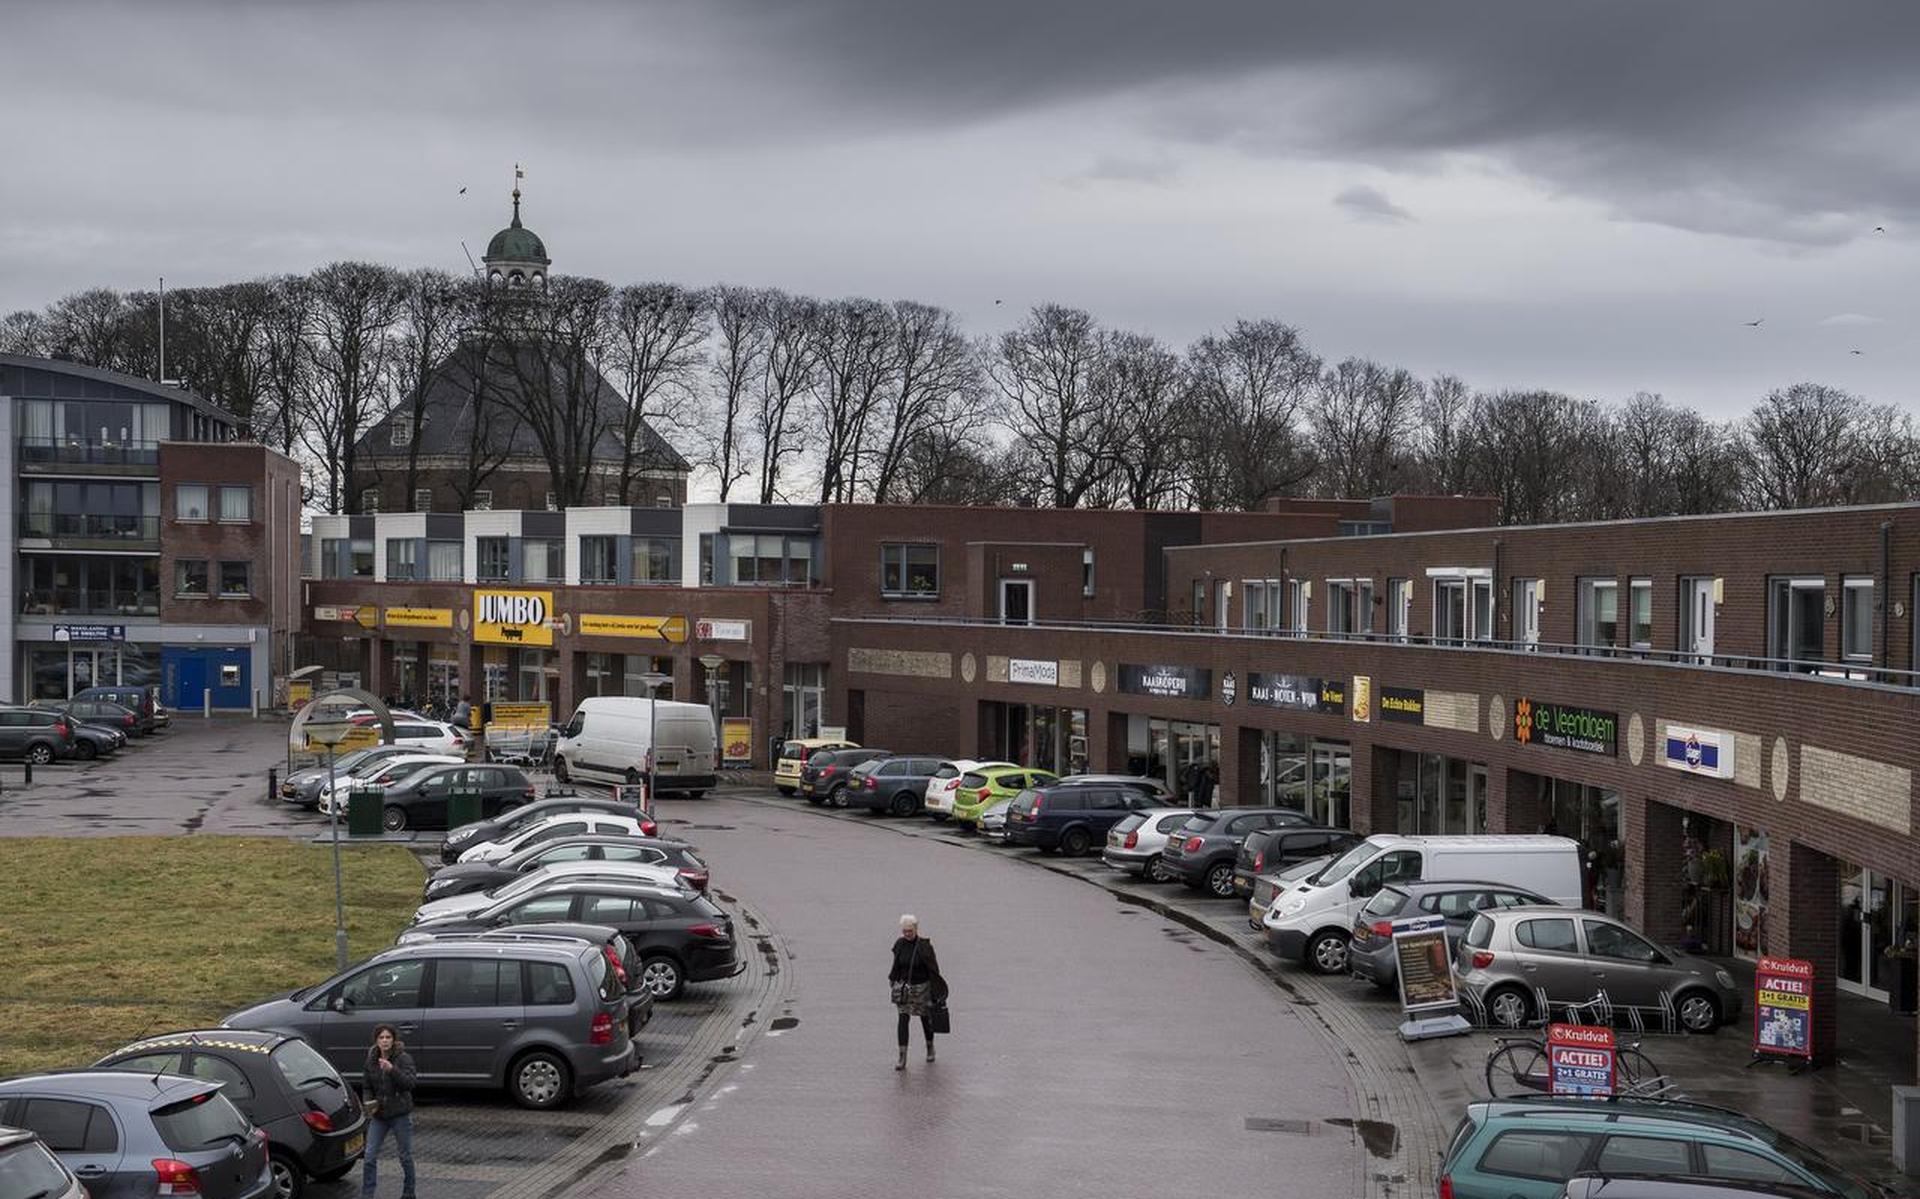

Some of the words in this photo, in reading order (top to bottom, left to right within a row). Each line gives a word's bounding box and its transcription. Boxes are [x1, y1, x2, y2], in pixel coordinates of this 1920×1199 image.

[478, 595, 545, 625] JUMBO
[1535, 705, 1550, 731] de
[1553, 706, 1615, 742] Veenbloem
[1770, 961, 1809, 975] Kruidvat
[1764, 979, 1803, 993] ACTIE!
[1777, 993, 1808, 1004] GRATIS
[1565, 1029, 1609, 1043] Kruidvat
[1559, 1051, 1604, 1067] ACTIE!
[1557, 1068, 1573, 1077] 2+1
[1574, 1069, 1607, 1080] GRATIS
